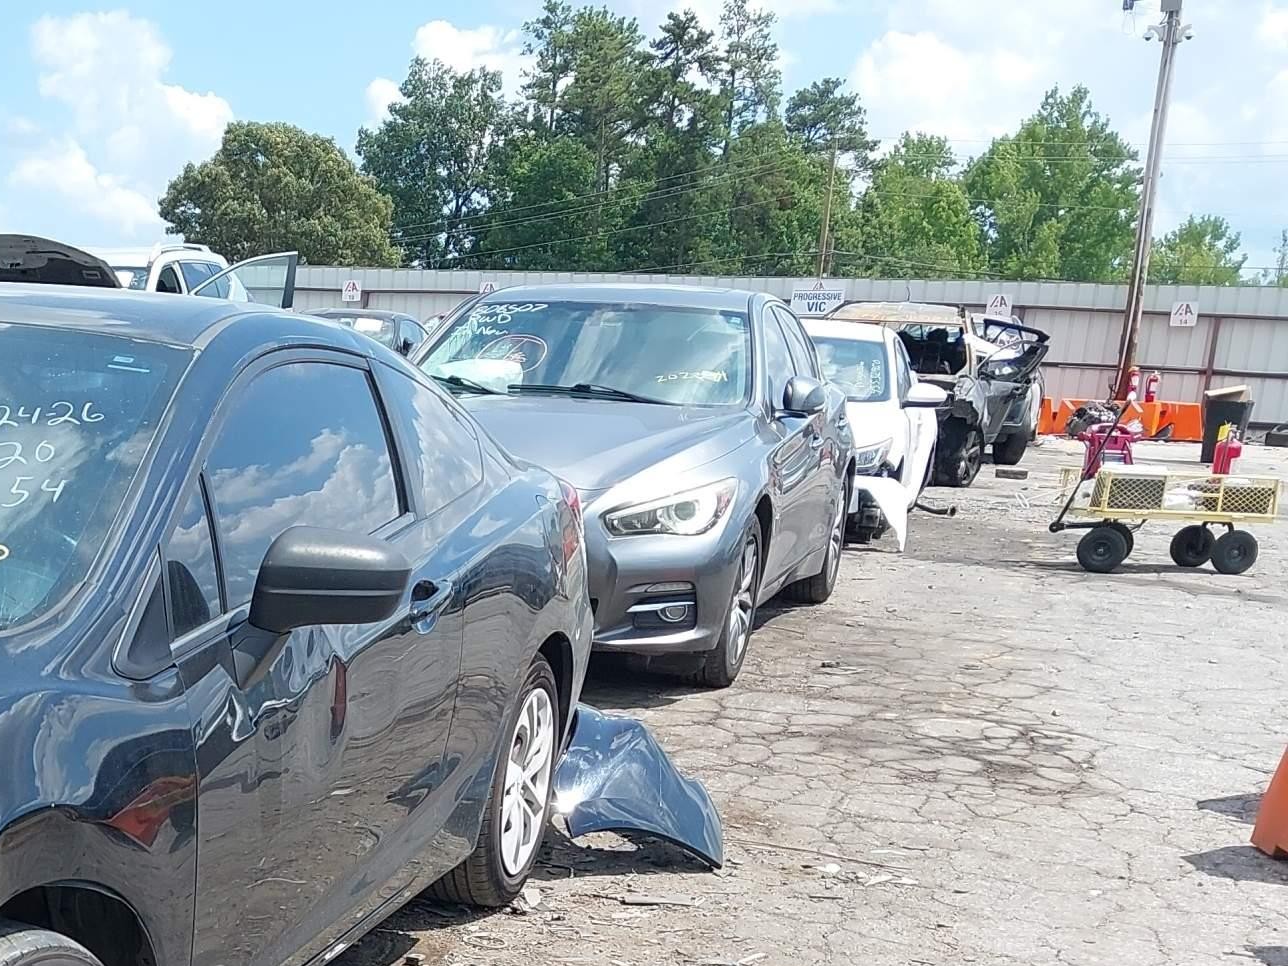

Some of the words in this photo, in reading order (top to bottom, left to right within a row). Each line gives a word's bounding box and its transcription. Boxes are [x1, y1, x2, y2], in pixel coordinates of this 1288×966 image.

[793, 292, 843, 301] PROGRESSIVE
[807, 301, 827, 312] VIC
[0, 476, 69, 508] 54
